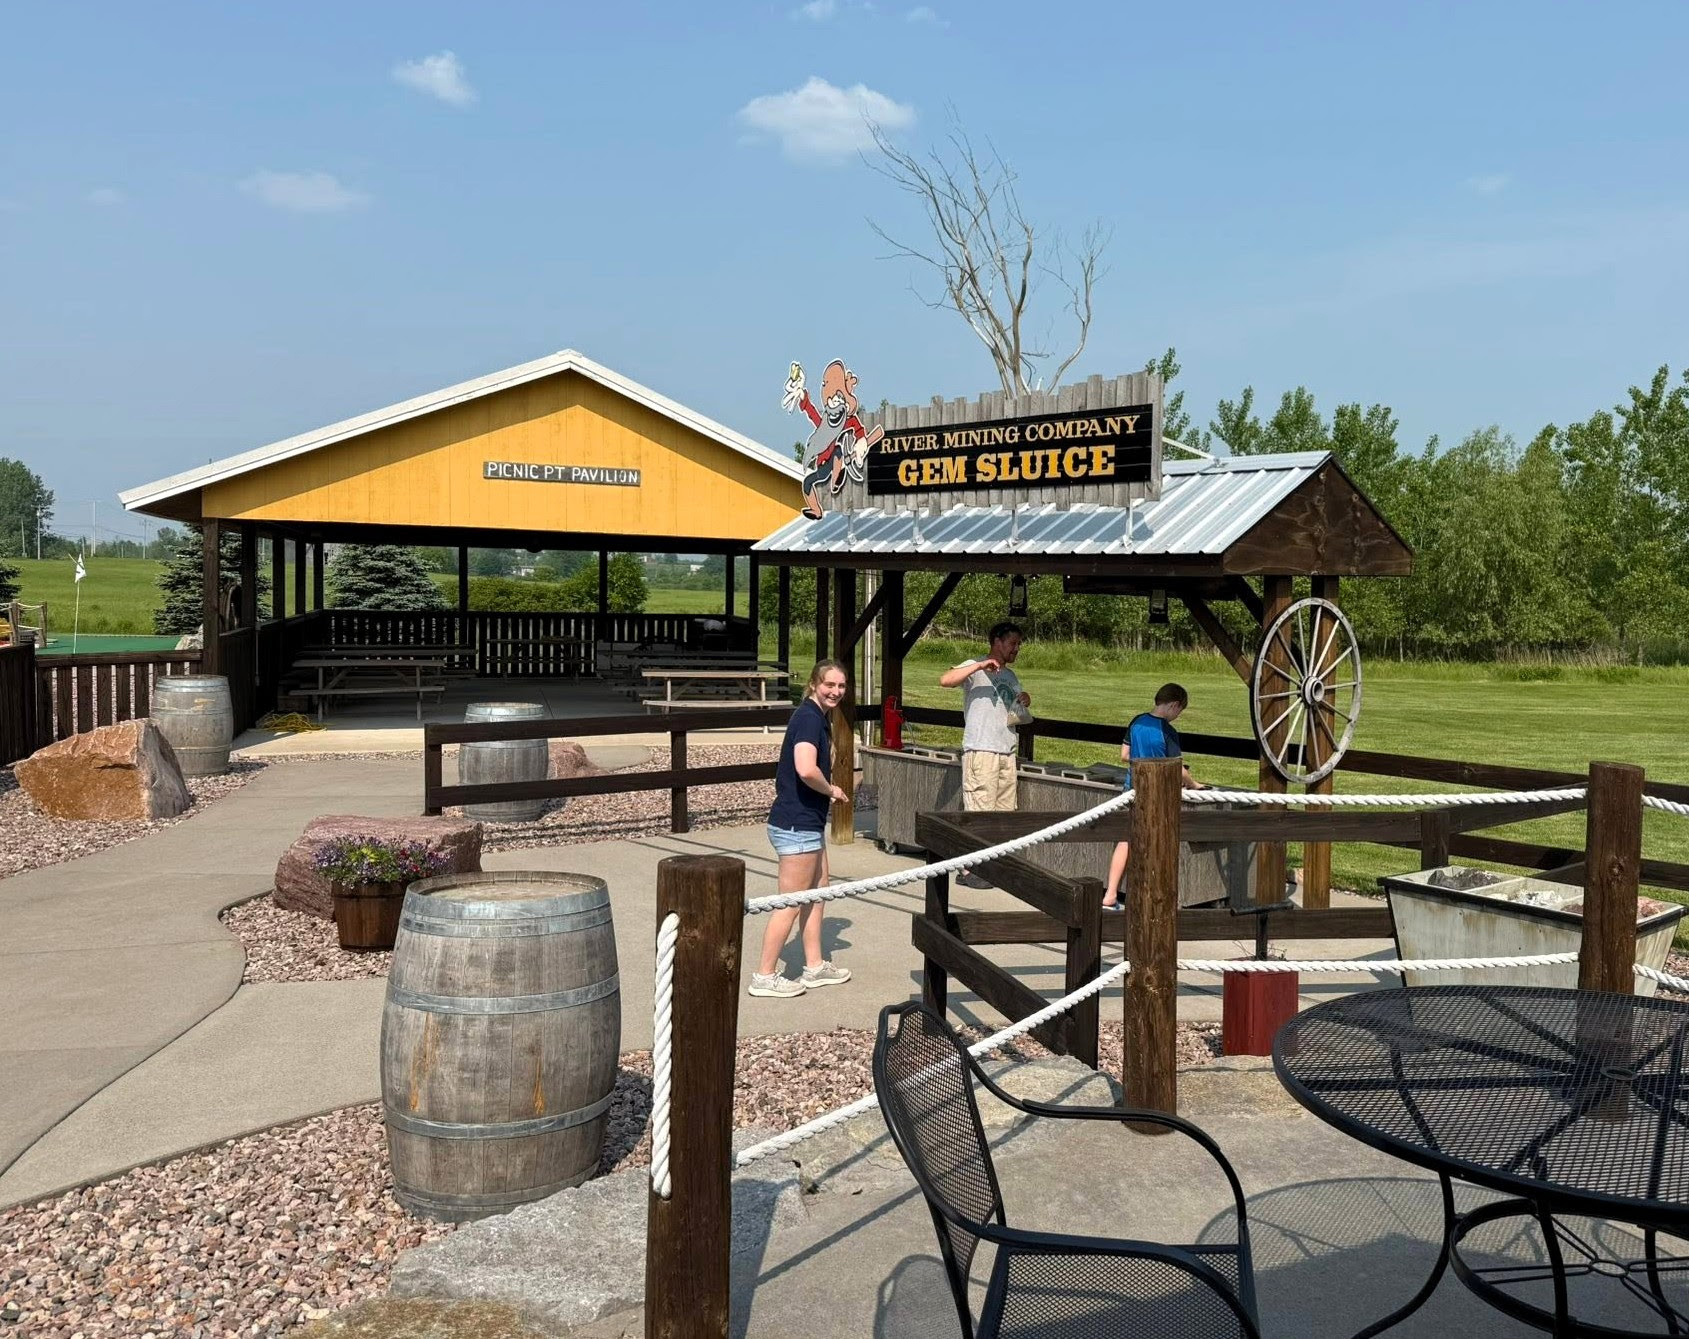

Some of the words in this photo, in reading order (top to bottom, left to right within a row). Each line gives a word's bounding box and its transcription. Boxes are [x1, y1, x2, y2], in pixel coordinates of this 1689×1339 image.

[880, 434, 939, 454] RIVER
[943, 426, 1020, 448] MINING
[1025, 415, 1140, 441] COMPANY
[487, 462, 539, 478] PICNIC
[544, 466, 565, 479] PT
[572, 467, 638, 483] PAVILION
[897, 456, 968, 487] GEM
[976, 445, 1116, 482] SLUICE
